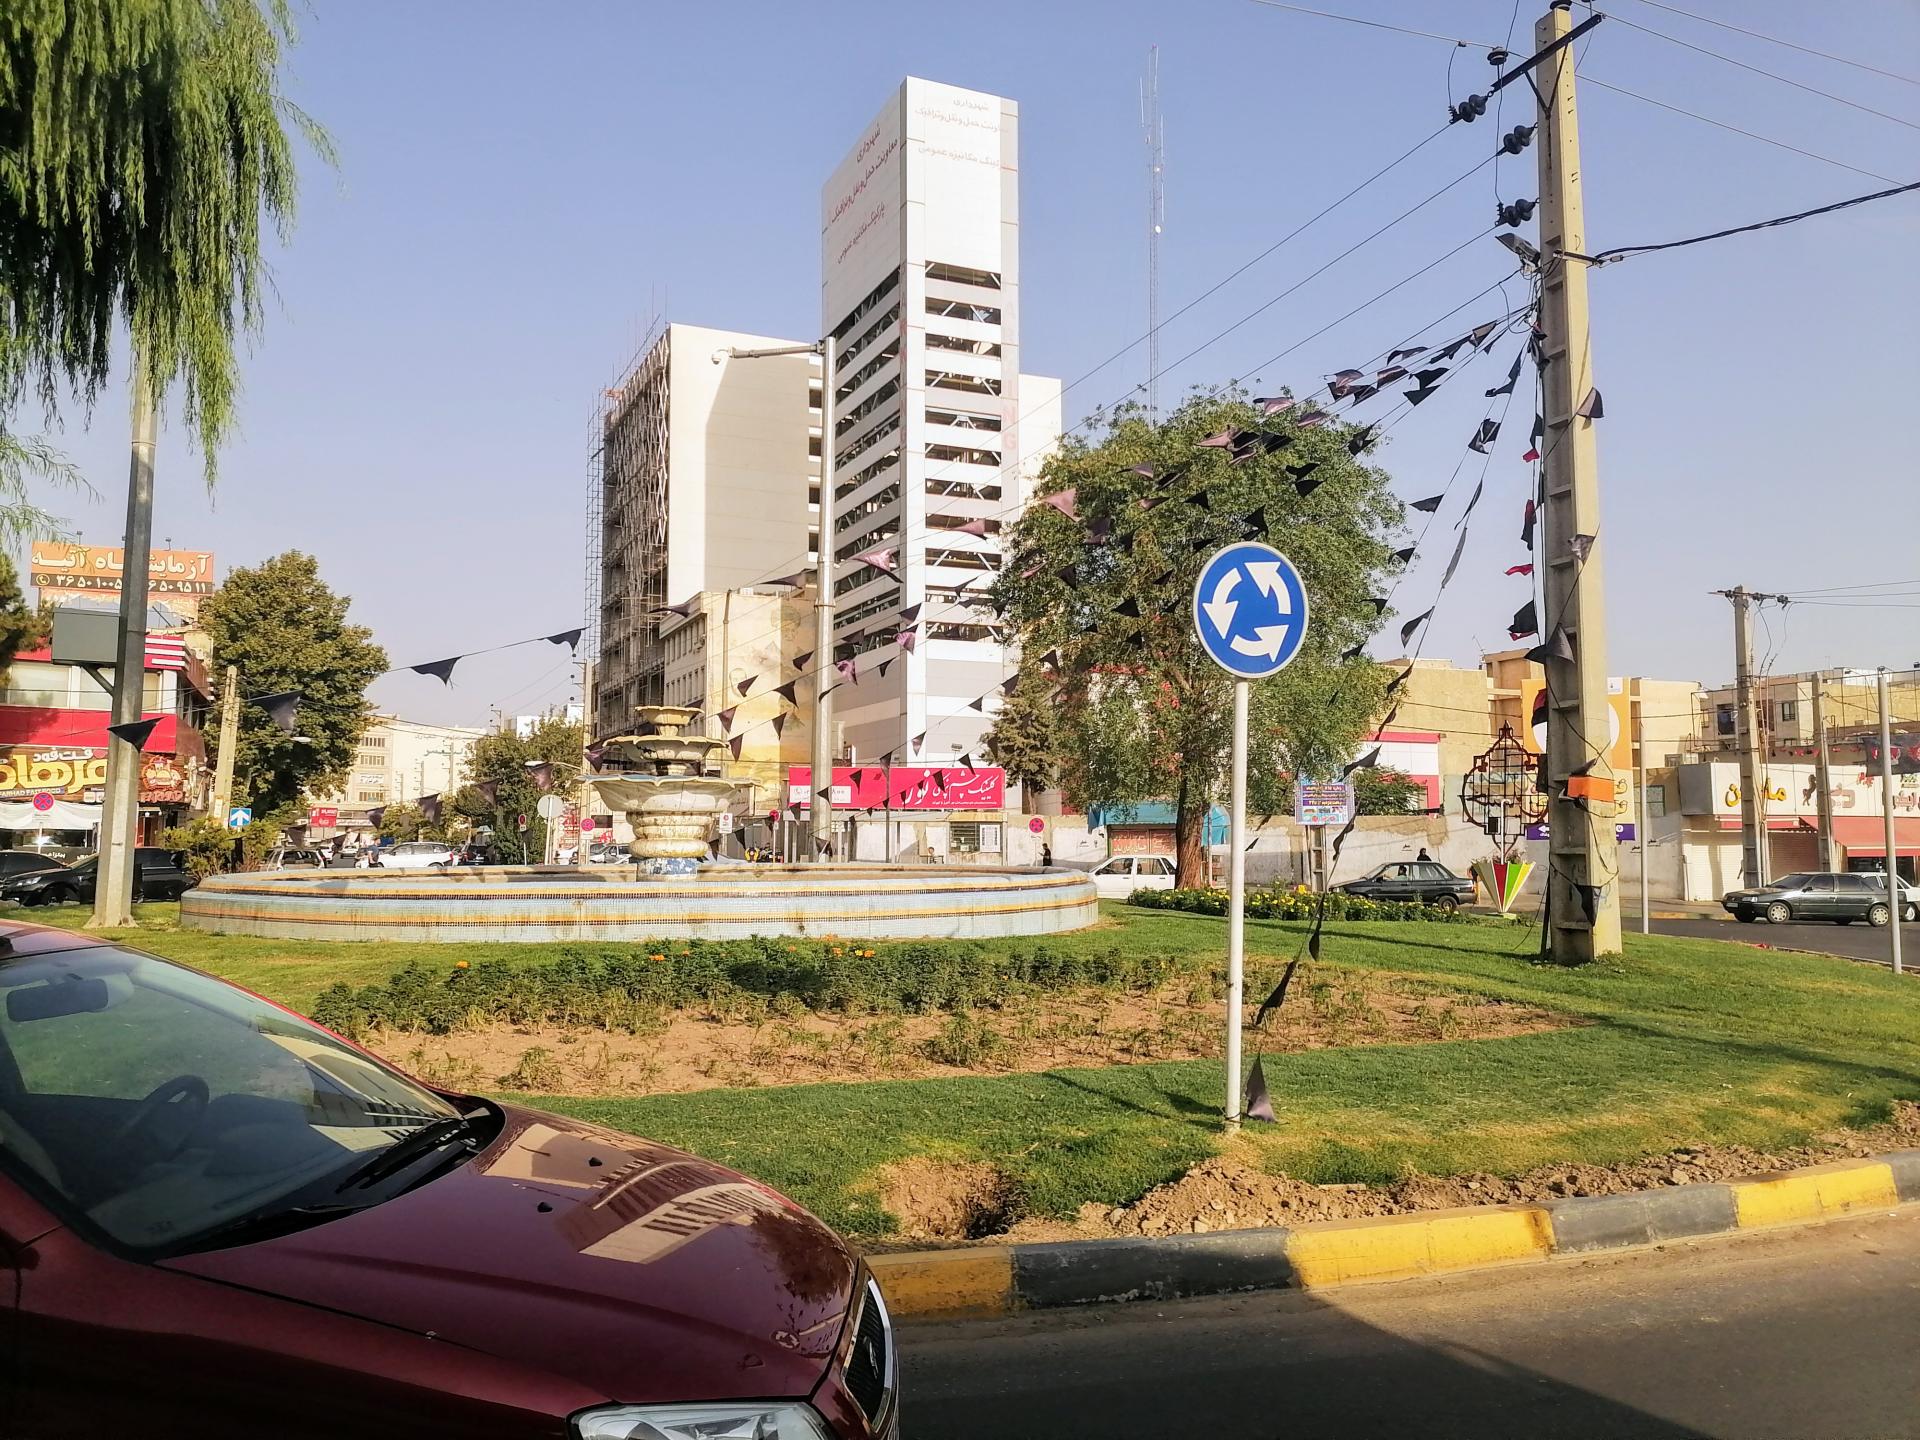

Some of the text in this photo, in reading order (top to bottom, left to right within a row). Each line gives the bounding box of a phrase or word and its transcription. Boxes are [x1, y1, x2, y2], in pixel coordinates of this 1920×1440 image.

[32, 547, 211, 580] آزمایشاه آتیه
[901, 768, 931, 806] نور
[967, 774, 1000, 801] کلینیک
